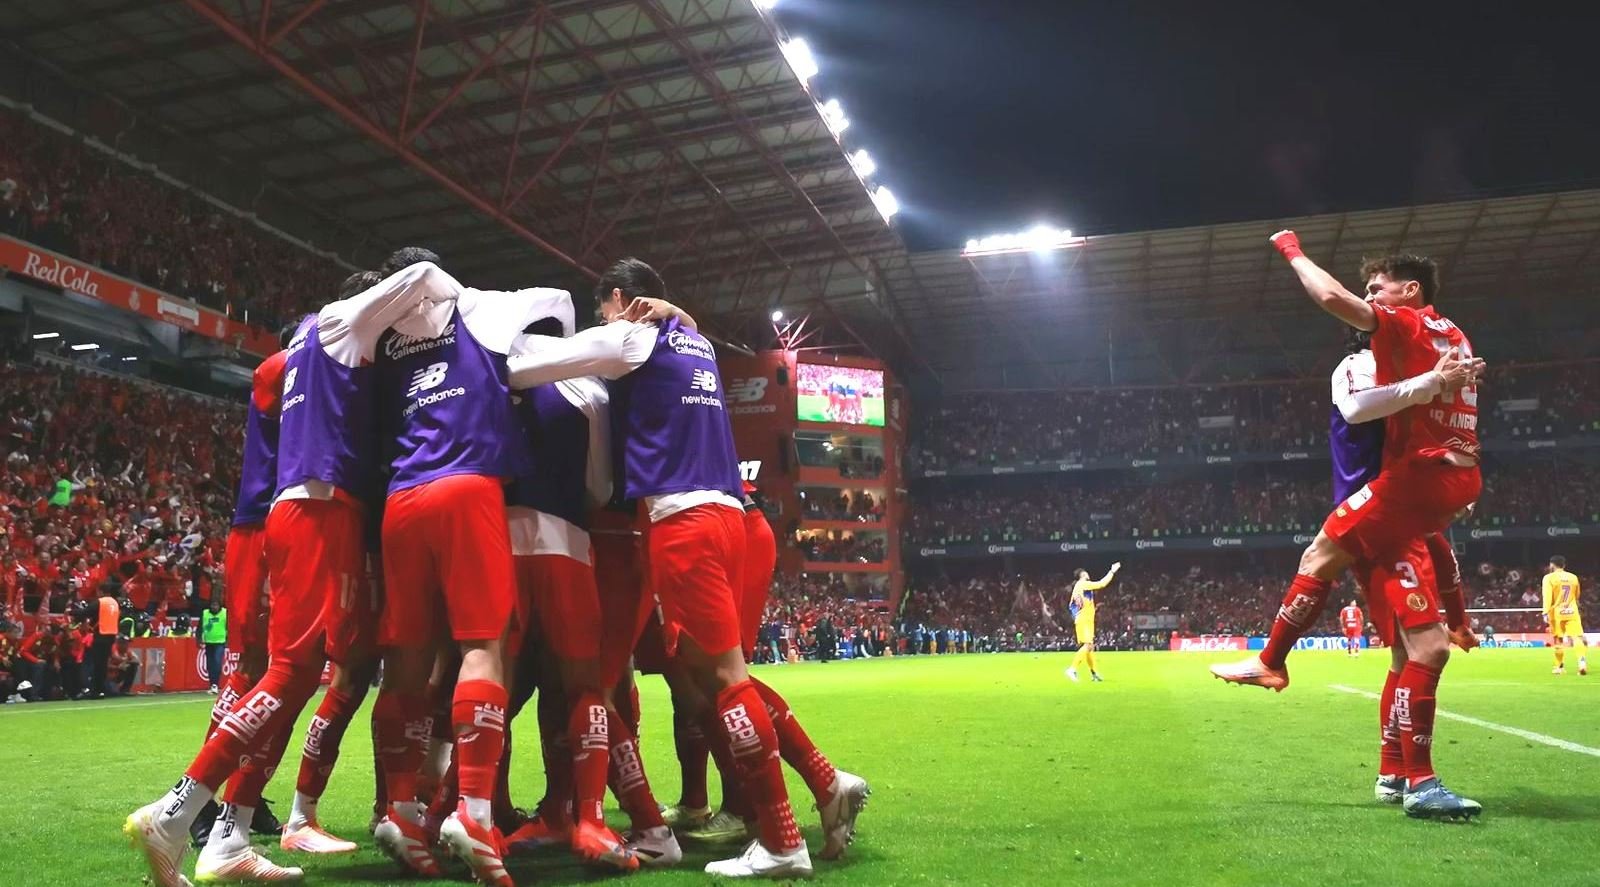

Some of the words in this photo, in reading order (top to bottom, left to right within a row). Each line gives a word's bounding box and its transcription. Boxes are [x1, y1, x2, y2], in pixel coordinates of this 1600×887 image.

[23, 251, 99, 297] RedCola
[418, 386, 466, 407] balance
[681, 394, 701, 405] new
[700, 394, 723, 411] balan
[1395, 561, 1419, 589] 3
[1561, 585, 1571, 602] 7
